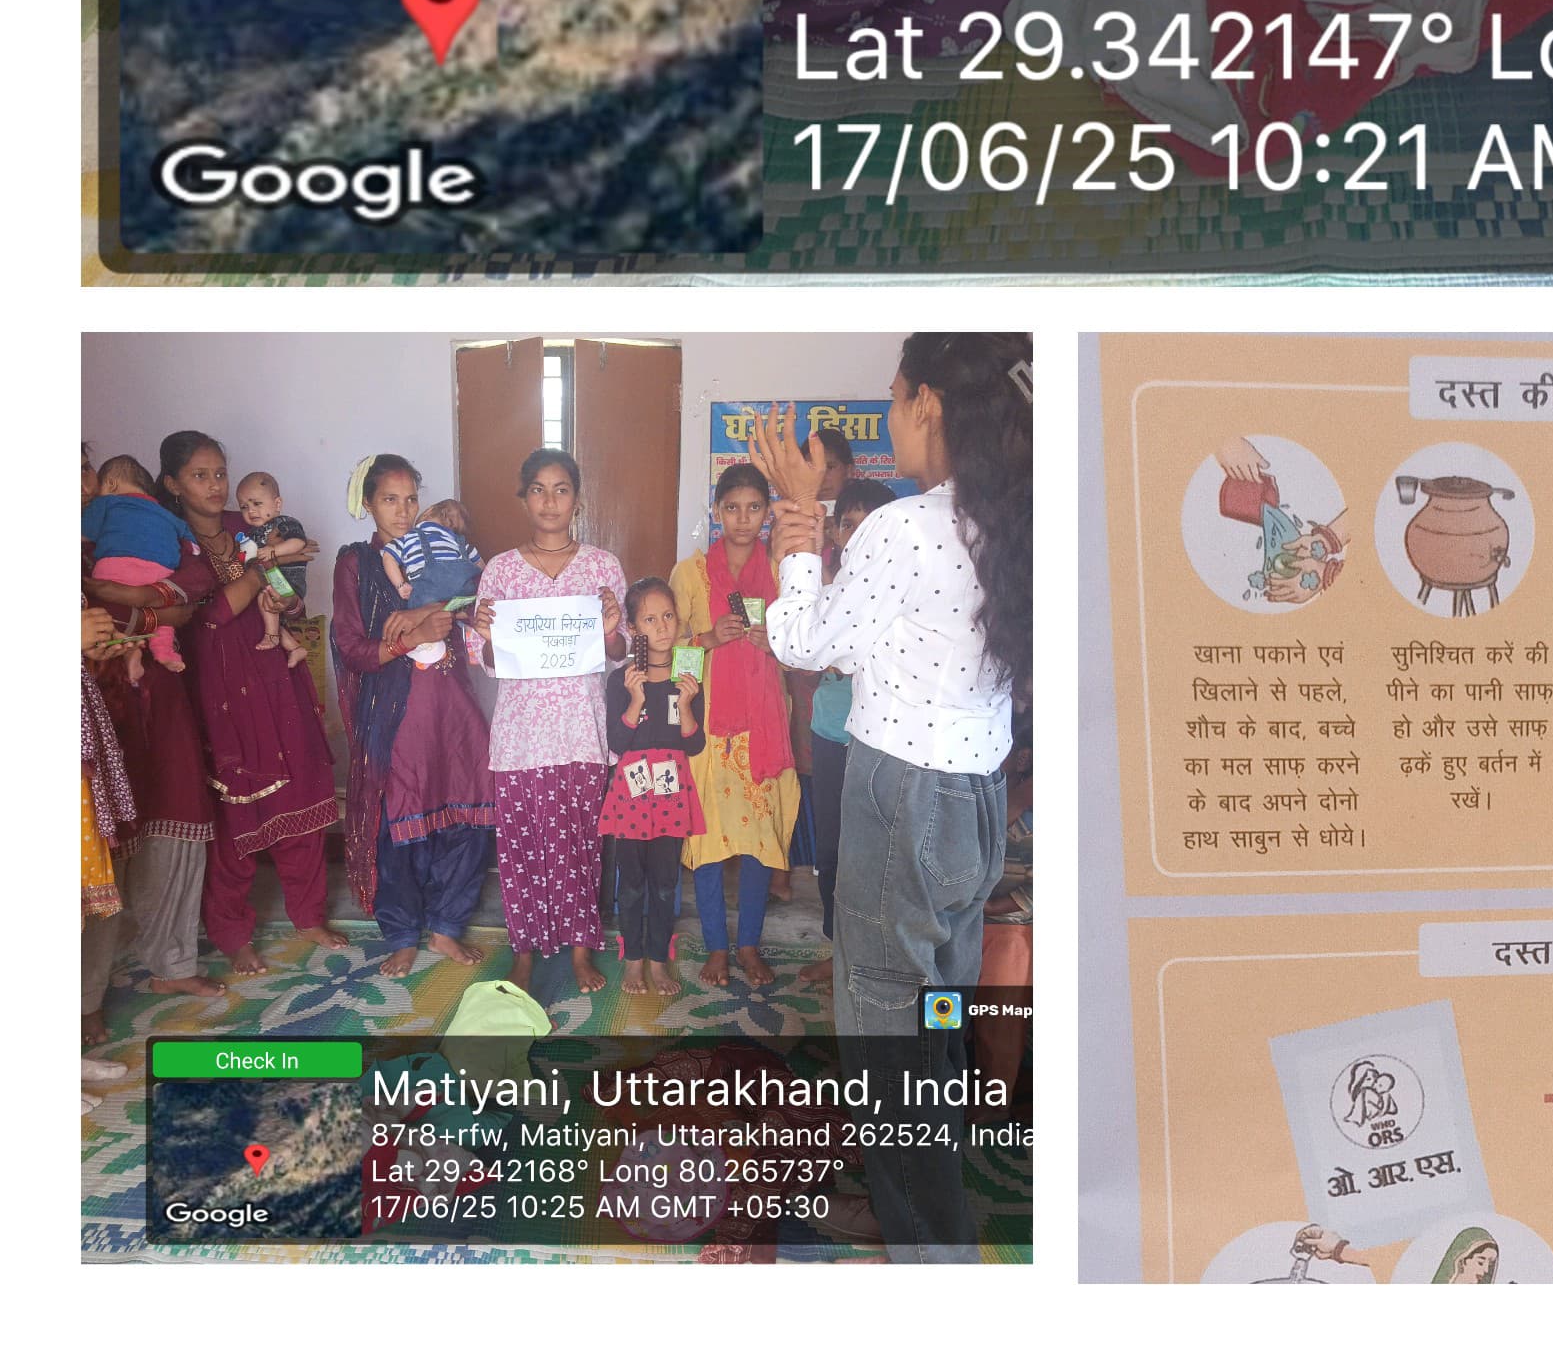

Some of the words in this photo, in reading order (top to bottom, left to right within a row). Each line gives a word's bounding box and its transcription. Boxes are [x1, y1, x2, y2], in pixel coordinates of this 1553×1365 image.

[1435, 380, 1502, 409] दस्त
[514, 614, 556, 634] डायरिया
[540, 652, 576, 670] 2025
[1194, 646, 1242, 664] खाना
[1254, 639, 1306, 664] पकाने
[1318, 641, 1344, 667] एवं
[1391, 641, 1475, 671] सुनिश्चित
[1485, 641, 1514, 664] करें
[1525, 641, 1549, 664] की
[1192, 677, 1258, 702] खिलाने
[1269, 677, 1287, 701] से
[1298, 677, 1347, 704] पहले,
[1386, 677, 1419, 701] पीने
[1430, 684, 1455, 701] का
[1465, 677, 1504, 701] पानी
[1514, 683, 1553, 704] साफ़
[1186, 715, 1226, 738] शौच
[1237, 715, 1256, 739] के
[1267, 721, 1306, 741] बाद,
[1317, 714, 1355, 738] बच्चे
[1392, 714, 1412, 738] हो
[1422, 713, 1456, 737] और
[1465, 714, 1498, 737] उसे
[1507, 720, 1548, 740] साफ़
[1184, 758, 1209, 775] का
[1221, 758, 1252, 775] मल
[1263, 758, 1305, 778] साफ़
[1316, 751, 1360, 775] करने
[1442, 756, 1467, 780] हुए
[1478, 749, 1518, 773] बर्तन
[1528, 749, 1542, 773] में
[1187, 788, 1206, 812] के
[1218, 795, 1252, 812] बाद
[1263, 788, 1307, 811] अपने
[1317, 787, 1359, 811] दोनो
[1183, 831, 1219, 849] हाथ
[1230, 830, 1280, 854] साबुन
[1291, 824, 1309, 847] से
[1492, 941, 1552, 966] दस्त
[1368, 1128, 1404, 1148] ORS
[1371, 1119, 1396, 1131] WHO
[1327, 1167, 1361, 1197] ओ.
[1368, 1161, 1414, 1188] आर.
[1415, 1150, 1461, 1178] एस.
